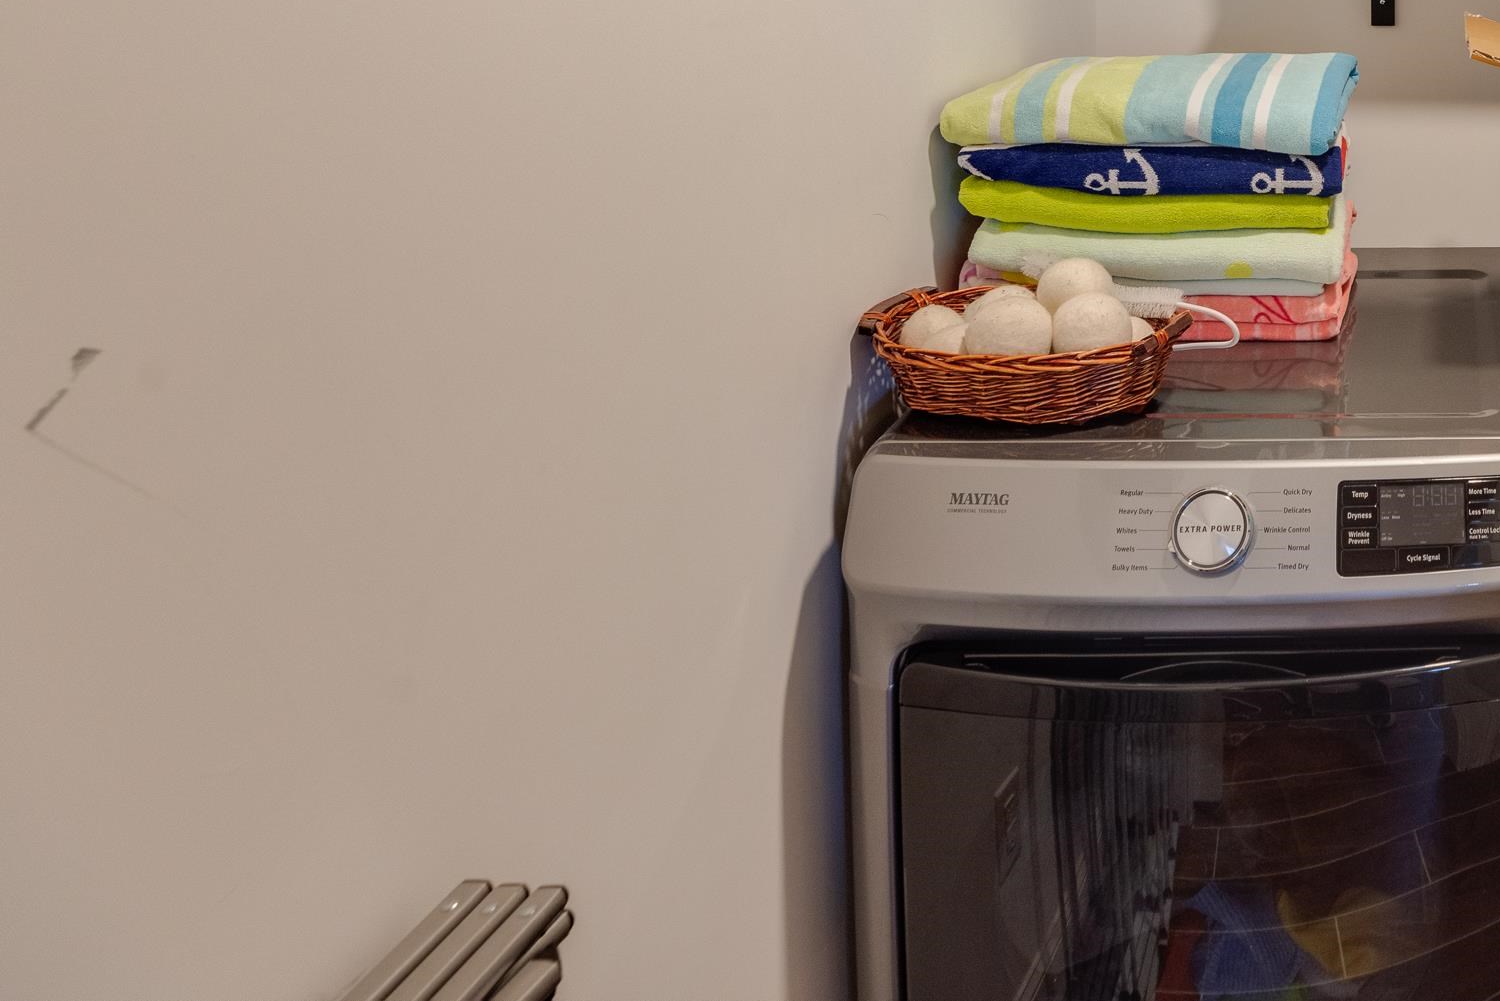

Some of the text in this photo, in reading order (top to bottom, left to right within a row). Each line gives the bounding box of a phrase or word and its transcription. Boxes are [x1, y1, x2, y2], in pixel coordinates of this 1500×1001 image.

[1120, 489, 1144, 498] Regular
[1283, 488, 1313, 497] Quick Dry
[1351, 491, 1369, 500] Temp
[1468, 487, 1497, 496] More Time
[949, 492, 1009, 506] MAYTAG
[1118, 508, 1154, 516] Heavy Duty
[1347, 511, 1372, 520] Dryness
[1116, 527, 1138, 535] Whites
[1179, 524, 1242, 533] EXTRA POWER
[1469, 527, 1489, 535] Control
[1348, 530, 1370, 538] Wrinkle
[1348, 537, 1370, 545] Prevent
[1114, 545, 1135, 553] Towels
[1406, 553, 1441, 563] Cycle Signal
[1111, 564, 1130, 572] Bulky
[1297, 563, 1309, 571] Dry
